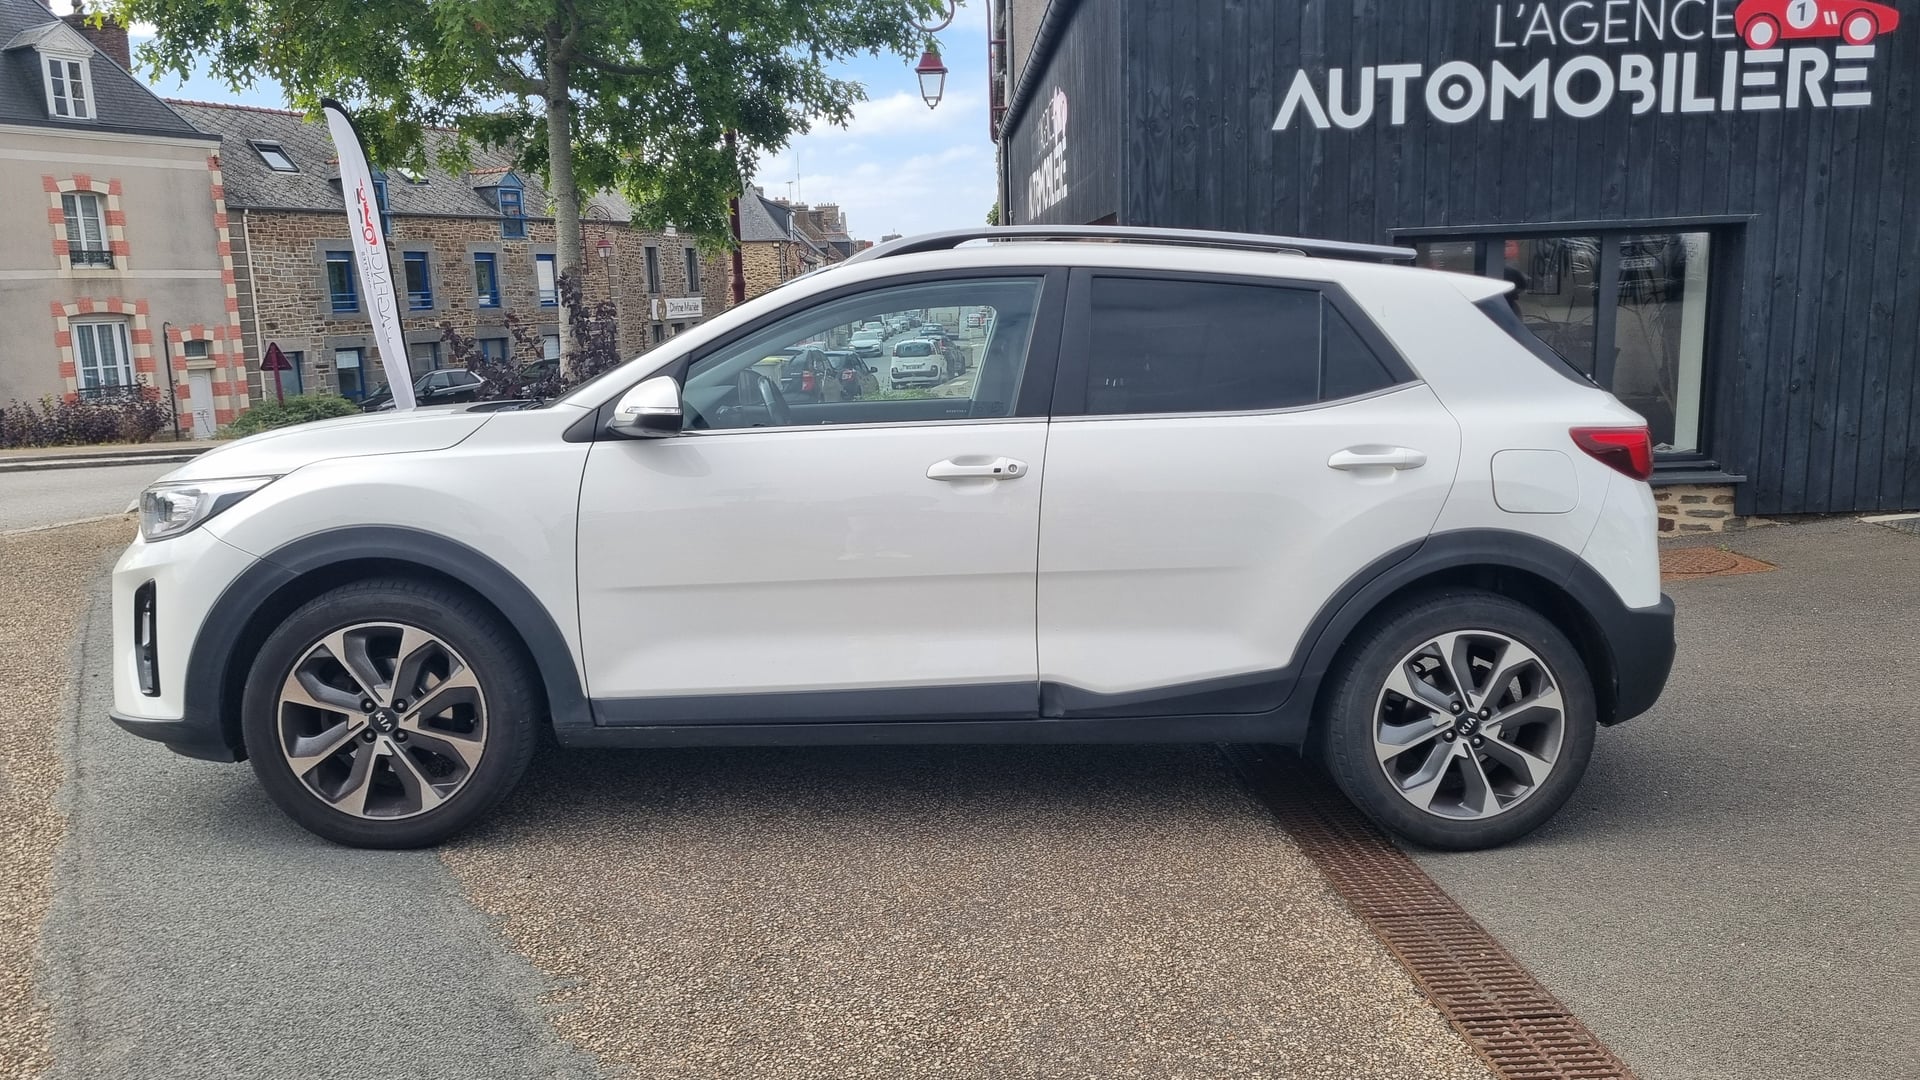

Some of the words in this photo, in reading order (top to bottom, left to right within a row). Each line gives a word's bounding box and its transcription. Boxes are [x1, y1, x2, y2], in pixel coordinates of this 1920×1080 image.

[1796, 2, 1806, 21] 1
[1495, 0, 1736, 47] L'AGENCE
[375, 711, 392, 731] KIA
[1460, 717, 1476, 734] KIA
